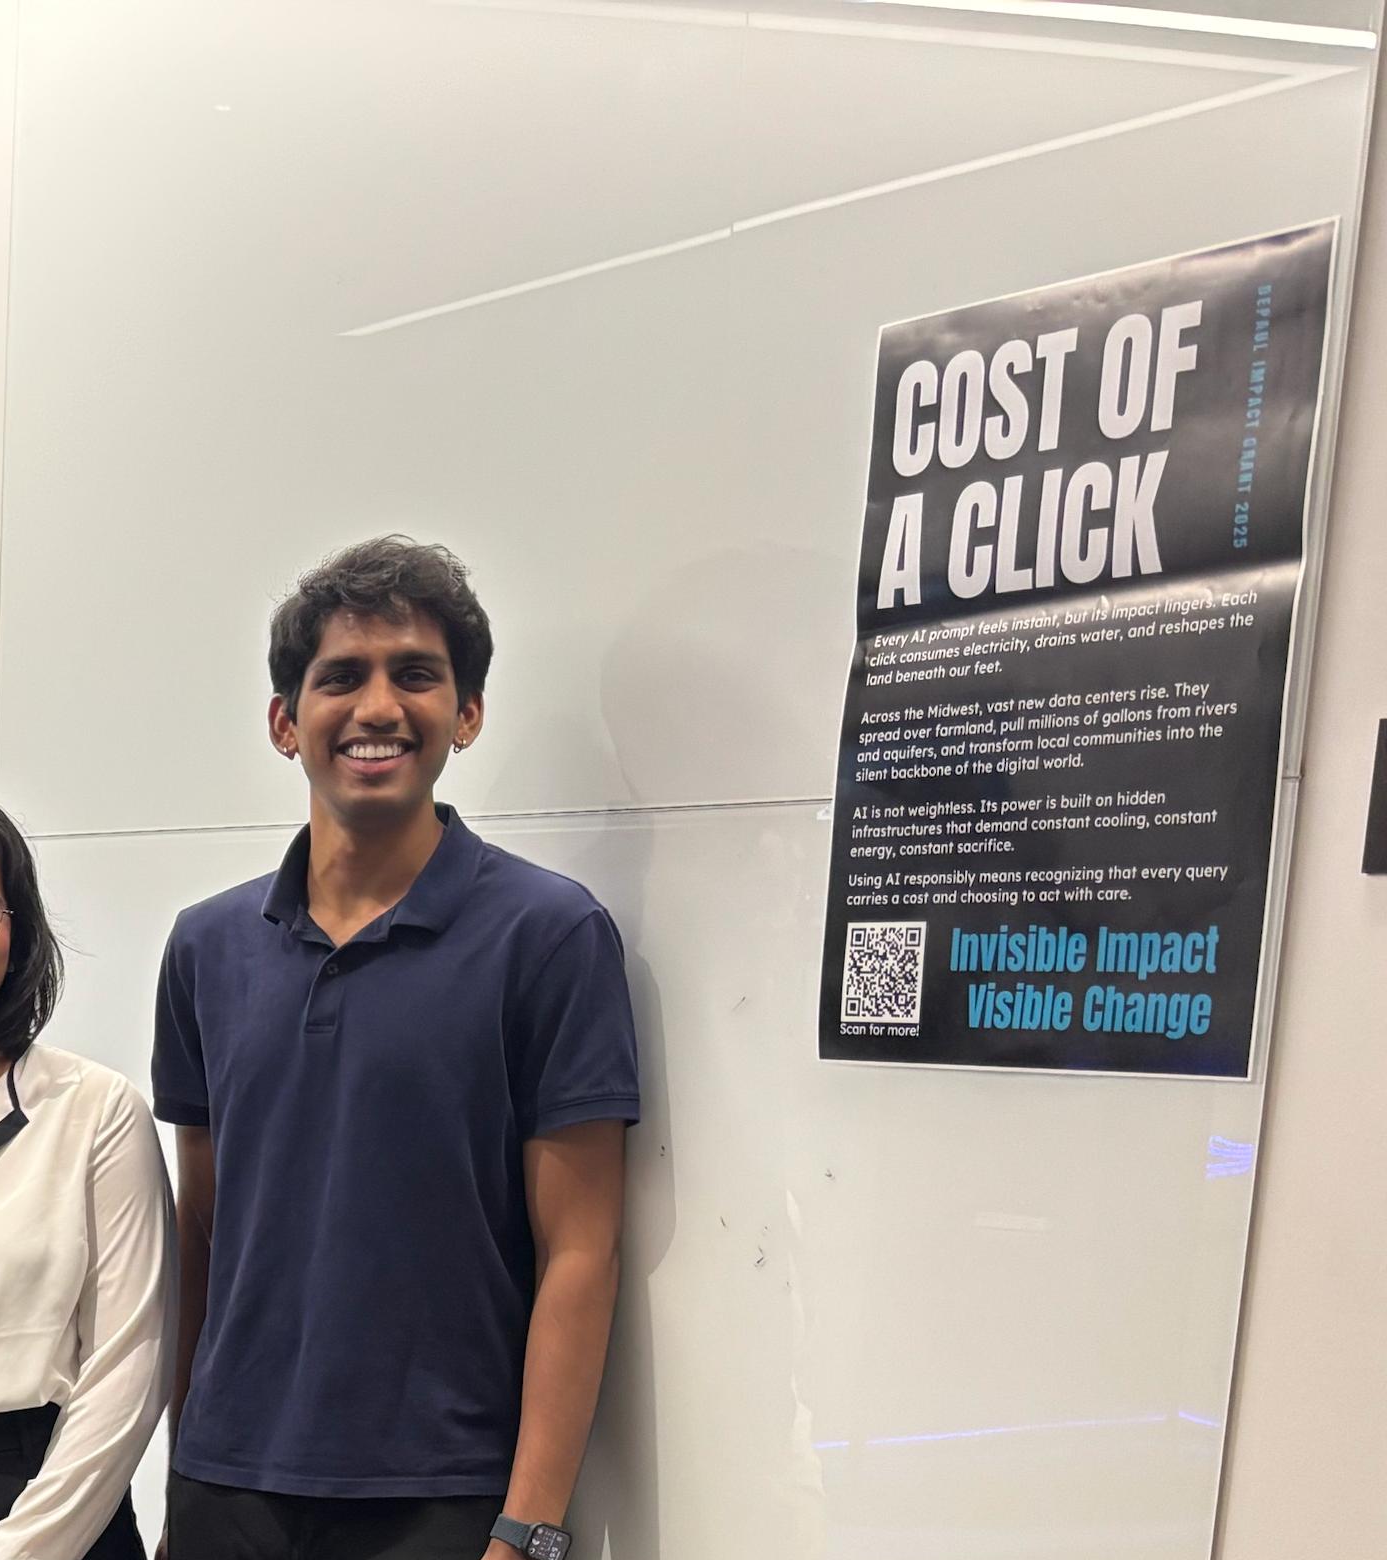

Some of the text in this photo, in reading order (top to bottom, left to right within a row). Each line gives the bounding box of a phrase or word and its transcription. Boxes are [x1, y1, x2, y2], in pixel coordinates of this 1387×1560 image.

[892, 299, 1203, 478] COST OF
[1245, 361, 1267, 428] IMPACT
[1237, 438, 1257, 493] GRANT
[876, 450, 1170, 610] A CLICK
[1232, 502, 1249, 549] 2025
[869, 612, 1254, 667] click consumes electricity, drains water, and reshapes the
[874, 590, 1257, 648] Every AI prompt feels instant, but its impact lingers. Each
[866, 660, 1002, 686] land beneath our feet.
[859, 701, 1237, 746] spread over farmland, pull millions of gallons from rivers
[861, 682, 1210, 724] Across the Midwest, vast new data centers rise. They
[857, 723, 1223, 763] and aquifers, and transform local communities into the
[855, 753, 1084, 782] silent backbone of the digital world.
[852, 809, 1218, 839] infrastructures that demand constant cooling, constant
[853, 790, 1166, 820] AI is not weightless. Its power is built on hidden
[850, 838, 1015, 860] energy, constant sacrifice.
[846, 886, 1132, 906] carries a cost and choosing to act with care.
[848, 865, 1228, 889] Using AI responsibly means recognizing that every query
[950, 924, 1219, 981] Invisible Impact
[839, 1022, 920, 1038] Scan for more!
[967, 981, 1212, 1040] Visible Change
